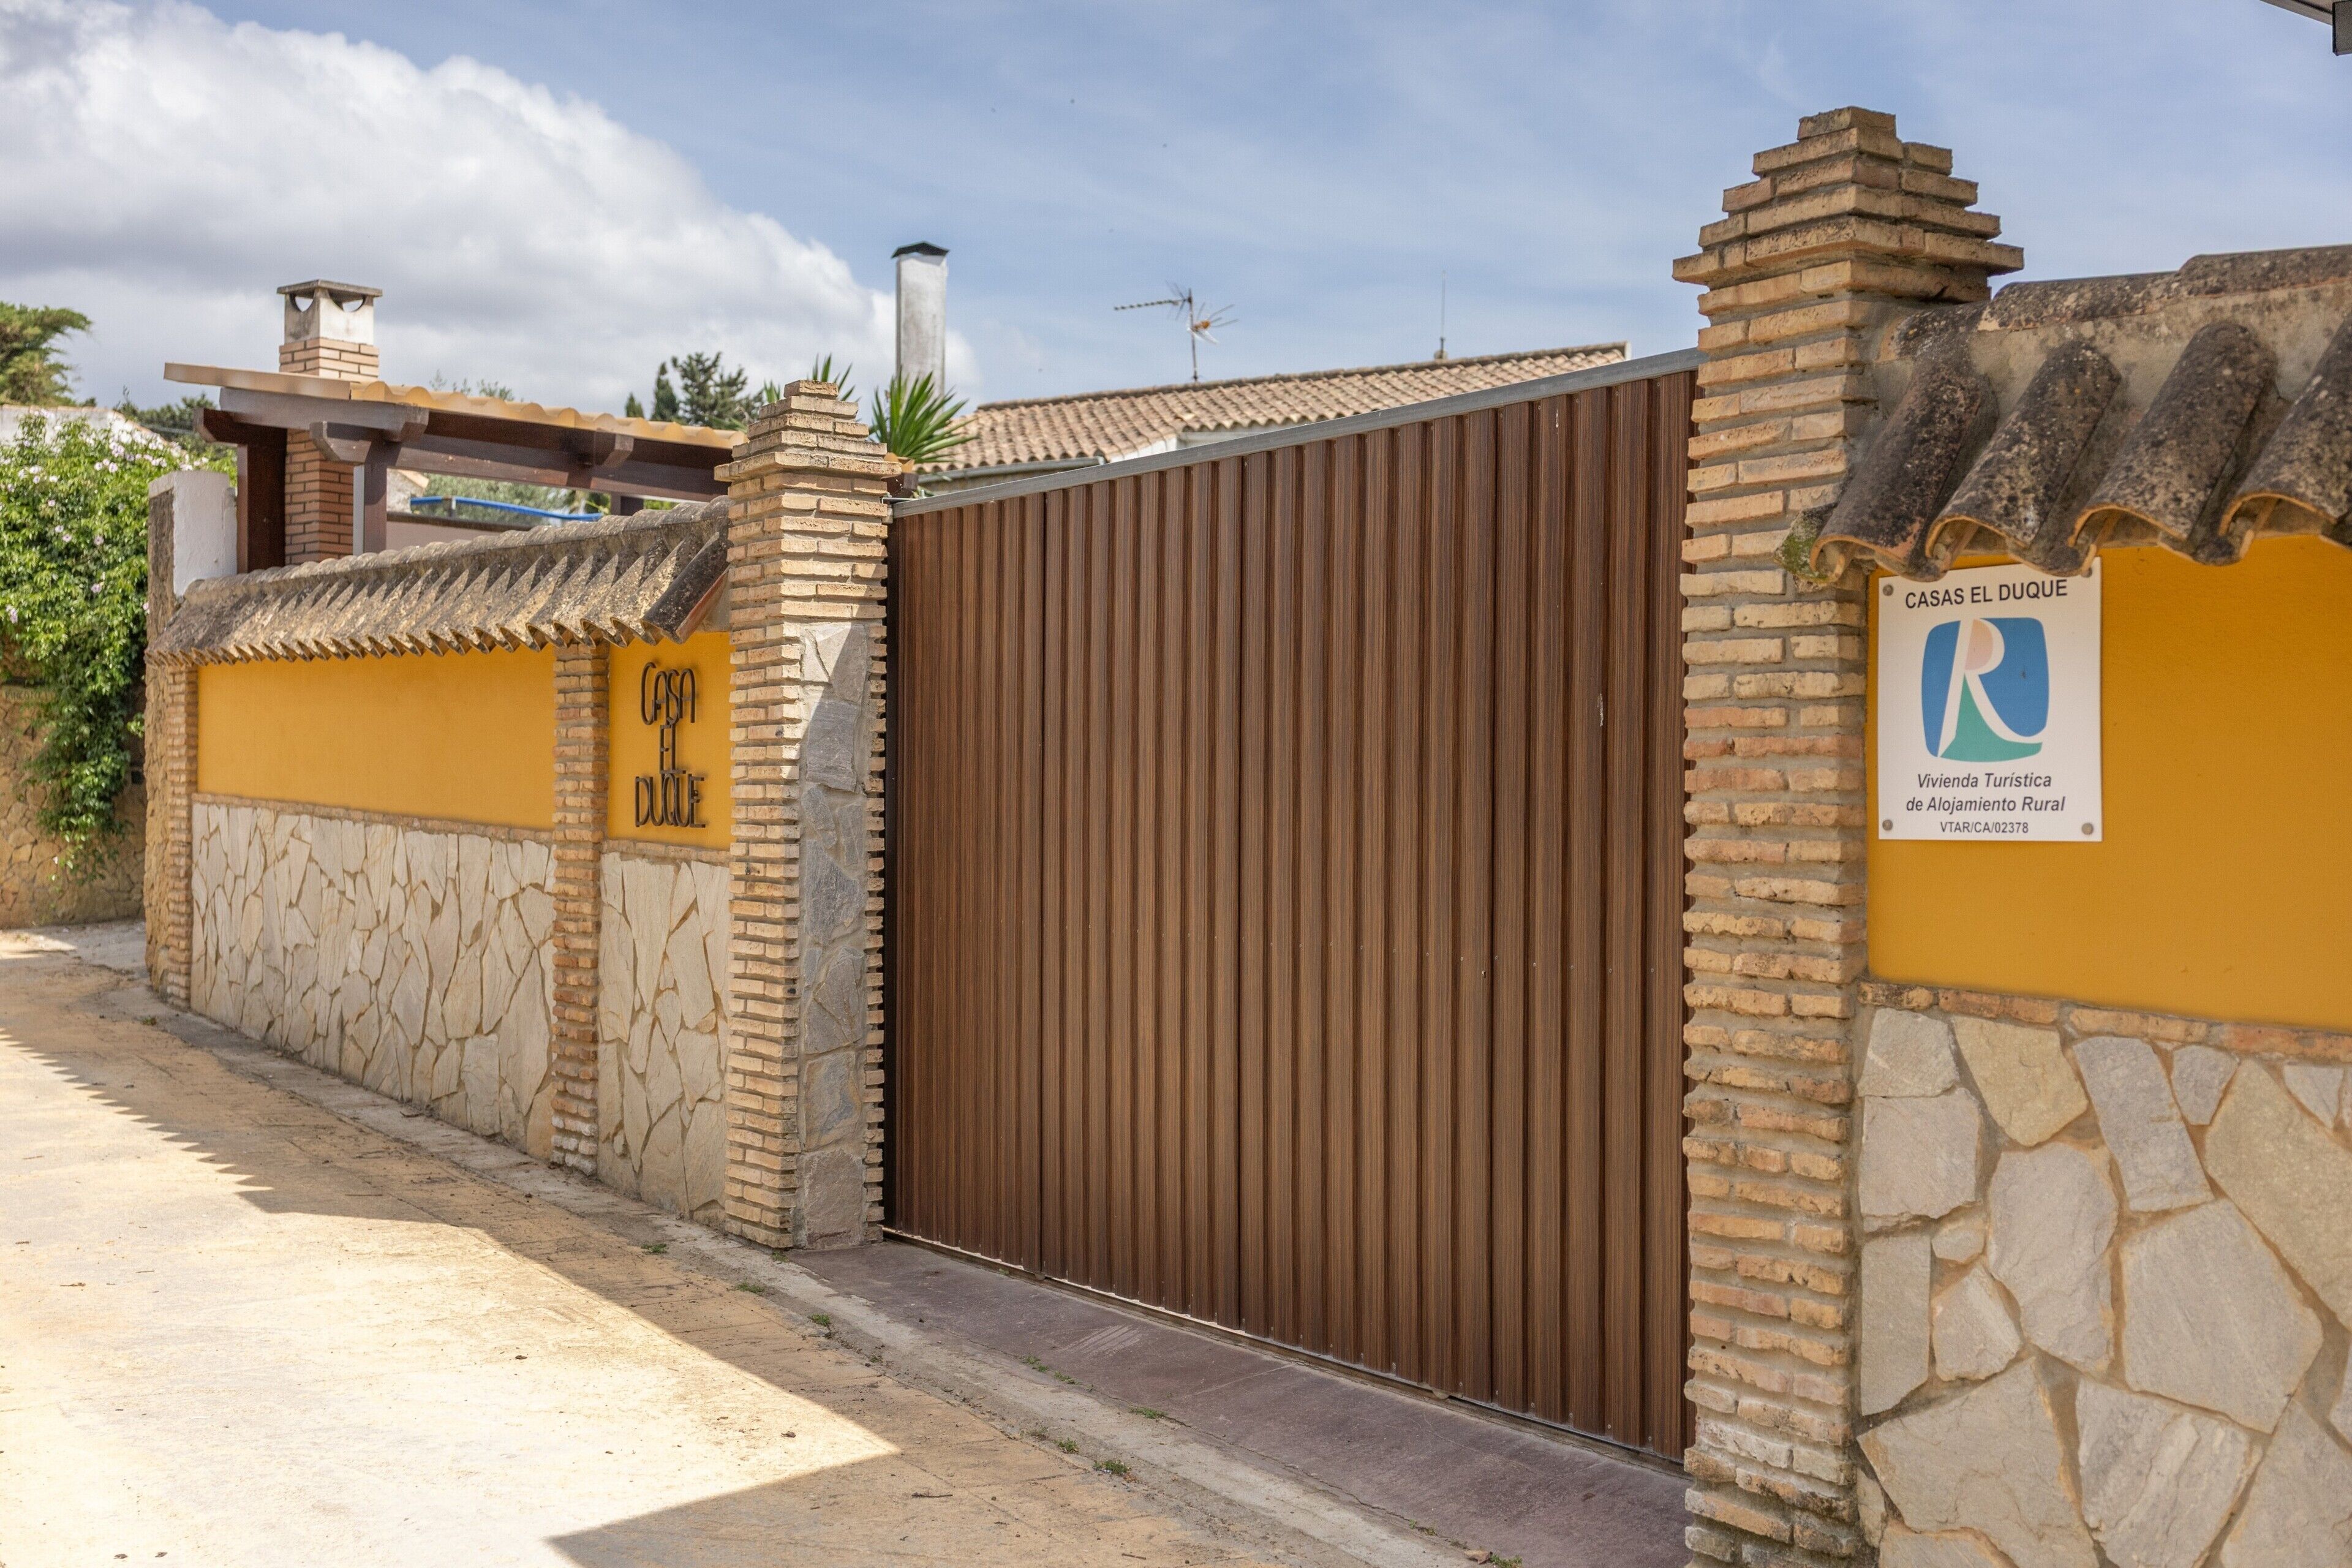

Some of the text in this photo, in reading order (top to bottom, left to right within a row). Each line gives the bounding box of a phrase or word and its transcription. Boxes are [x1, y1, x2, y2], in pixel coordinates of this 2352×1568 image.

[1905, 579, 2068, 609] CASAS EL DUQUE
[641, 662, 696, 725] CASA
[660, 723, 686, 775] EL
[1918, 772, 2052, 788] Vivienda Turística
[635, 773, 706, 827] DUQUE
[1906, 796, 2065, 815] de Alojamiento Rural
[1940, 821, 2029, 834] VTAR/CA/02378
